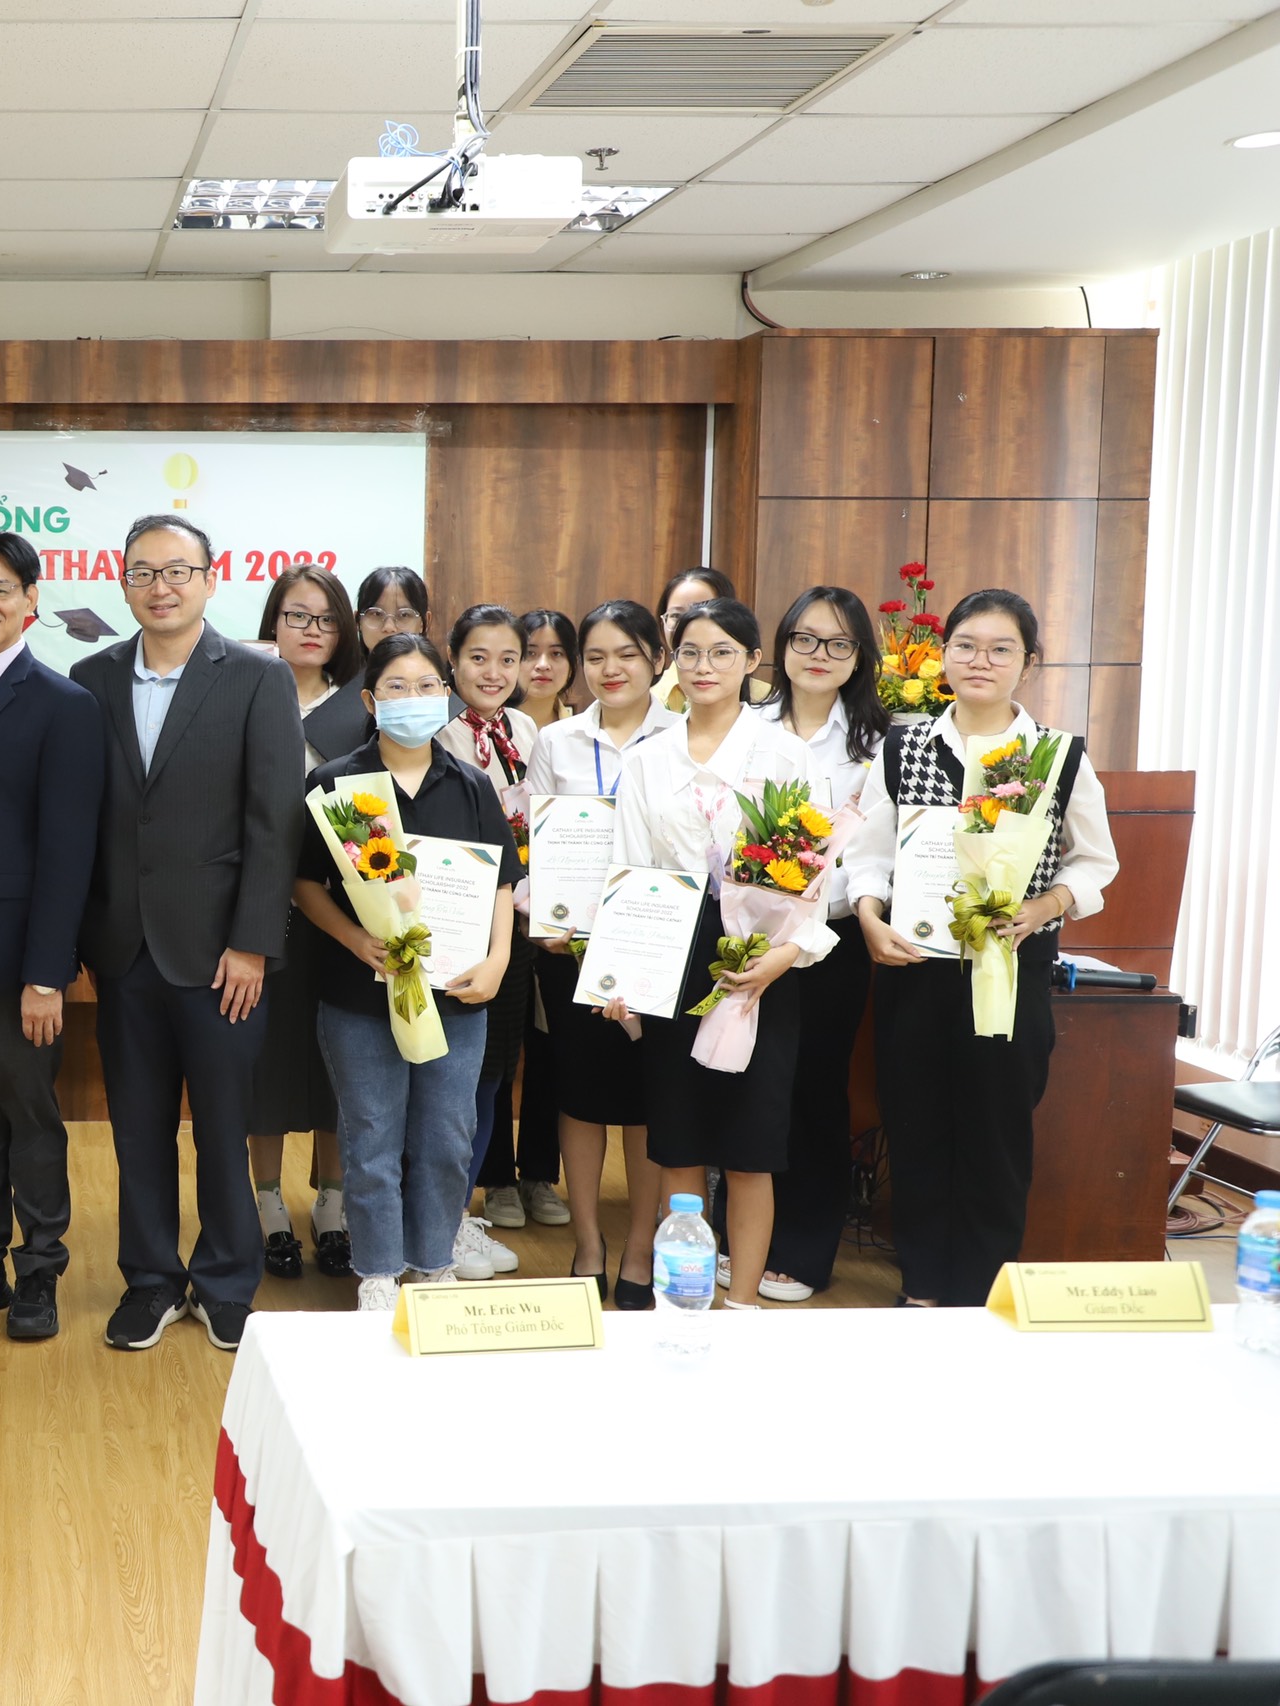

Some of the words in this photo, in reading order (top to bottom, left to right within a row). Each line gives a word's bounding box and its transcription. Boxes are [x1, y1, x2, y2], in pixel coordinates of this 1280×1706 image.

[1066, 1286, 1089, 1297] Mr.
[1092, 1286, 1124, 1299] Eddy
[464, 1306, 486, 1317] Mr.
[490, 1304, 516, 1315] Eric
[519, 1303, 541, 1314] Wu
[446, 1323, 468, 1336] Phó
[471, 1320, 502, 1336] Tổng
[505, 1321, 537, 1333] Giám
[541, 1316, 564, 1331] Đốc
